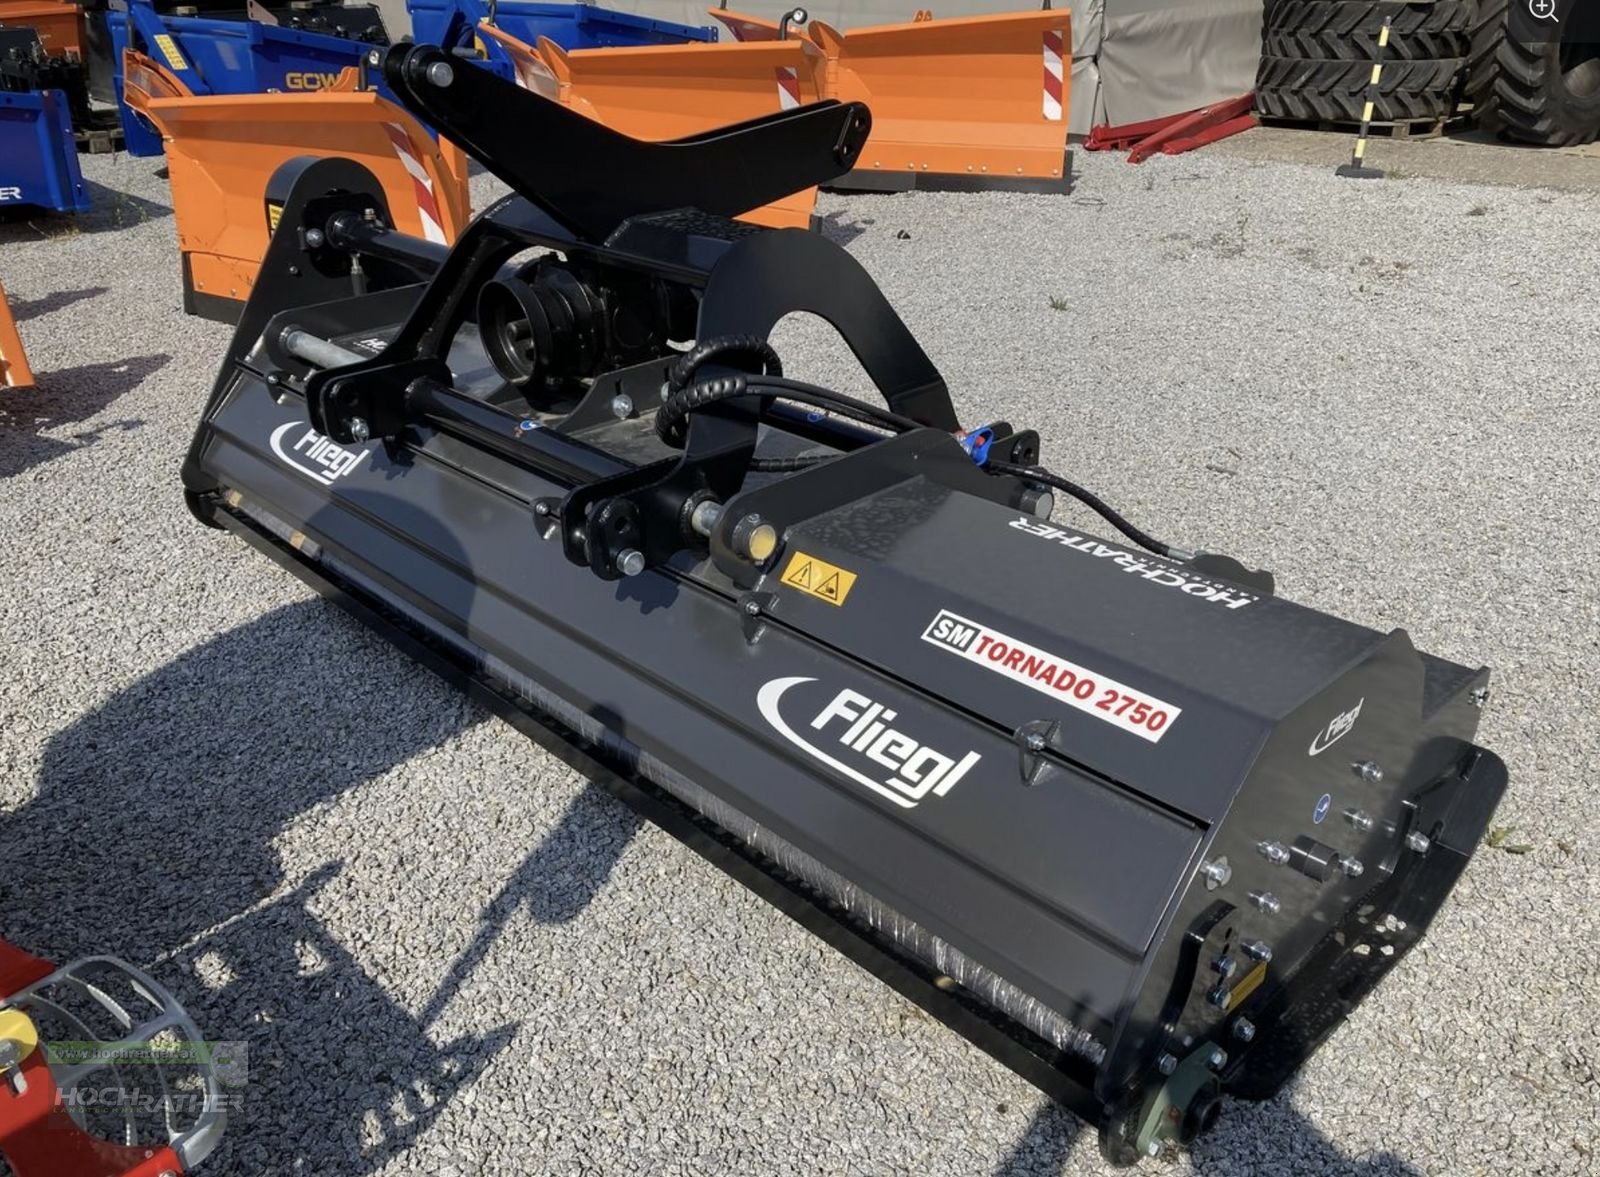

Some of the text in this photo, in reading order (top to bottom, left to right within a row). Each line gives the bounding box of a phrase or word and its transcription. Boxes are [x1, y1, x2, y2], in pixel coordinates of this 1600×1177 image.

[293, 427, 370, 480] Fliegl
[1008, 516, 1253, 609] HOCHRATHER
[932, 618, 1168, 732] SM TORNADO 2750
[1324, 697, 1365, 743] Fliegl
[811, 688, 982, 800] Fliegl
